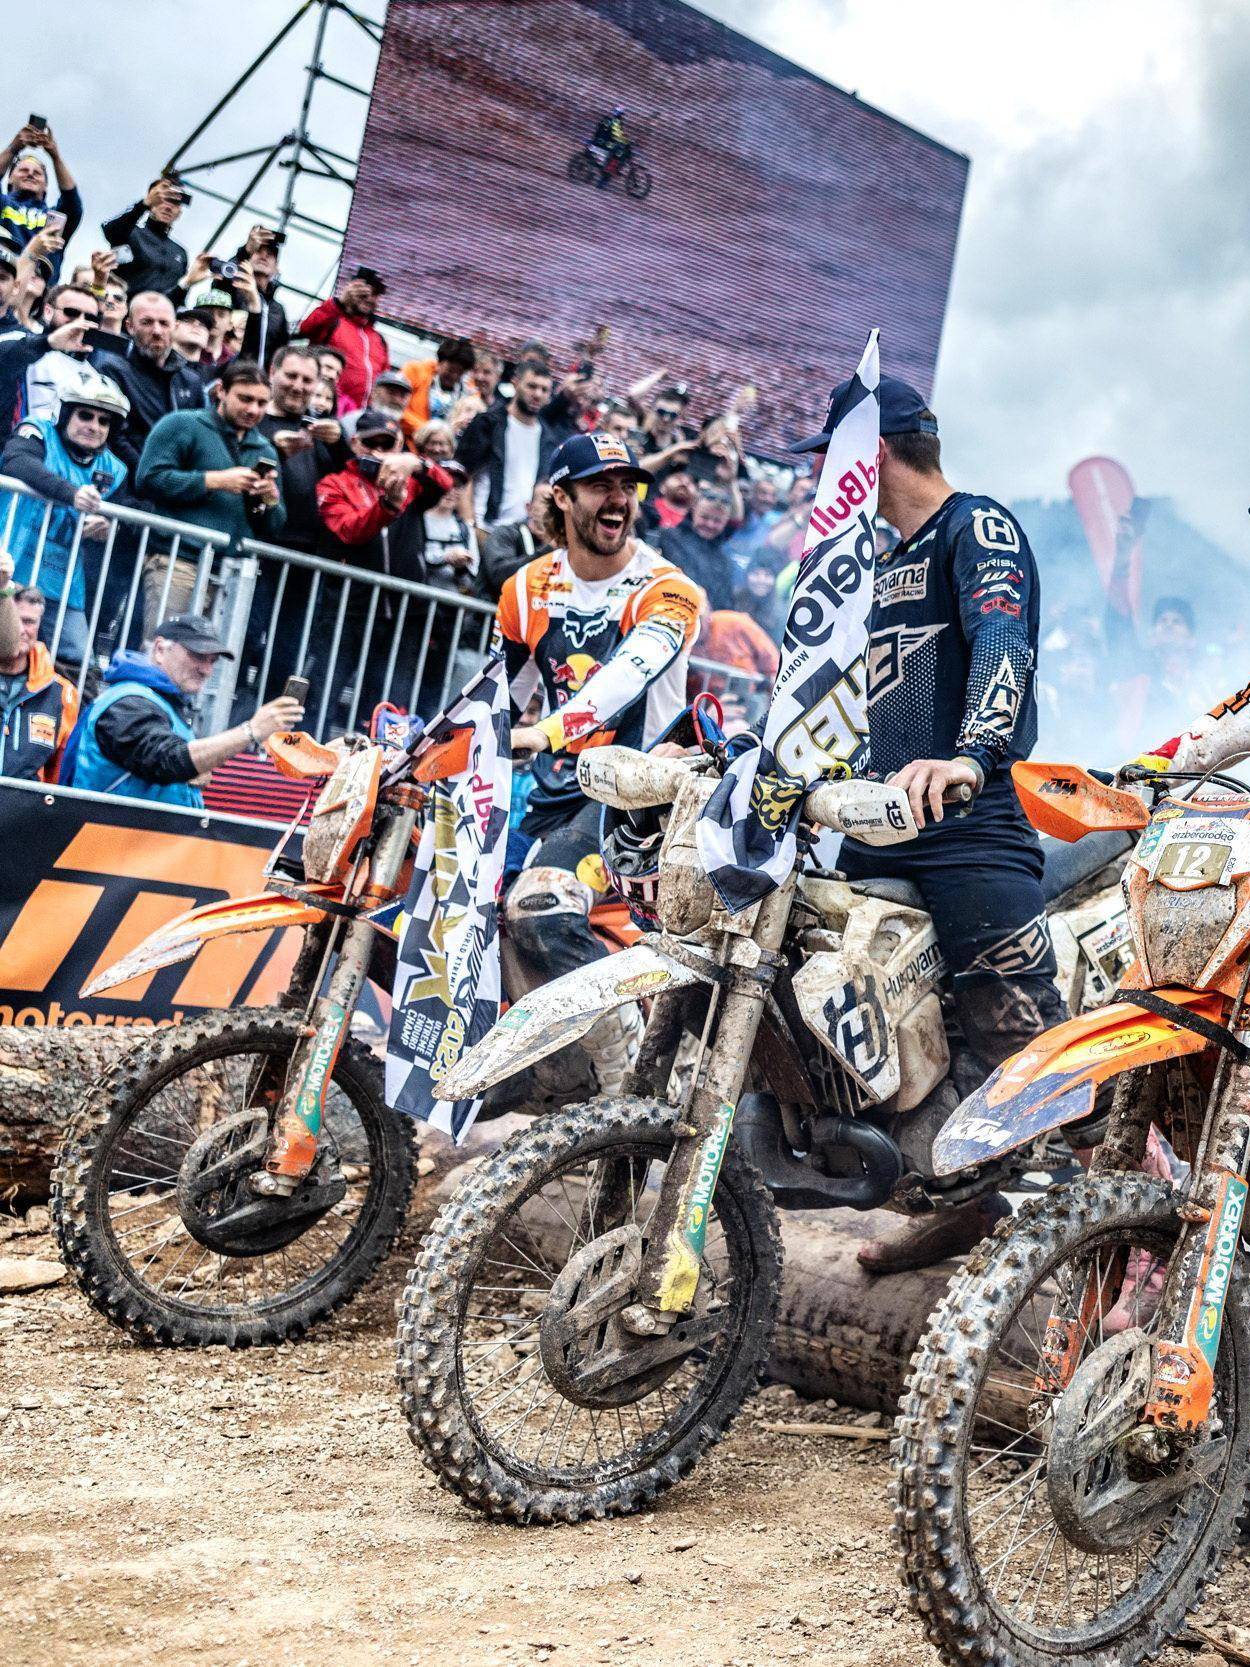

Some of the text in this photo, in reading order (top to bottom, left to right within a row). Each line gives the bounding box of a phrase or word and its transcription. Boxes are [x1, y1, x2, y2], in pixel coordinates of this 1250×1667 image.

[873, 566, 925, 598] sqvarna
[1038, 777, 1078, 795] KTM
[1172, 845, 1212, 879] 12
[402, 1008, 418, 1046] CHAMP
[408, 1012, 426, 1050] ENDURO
[417, 1017, 435, 1055] XTREME
[425, 1020, 442, 1058] ULTIMATE
[1205, 1192, 1245, 1304] MOTOREX
